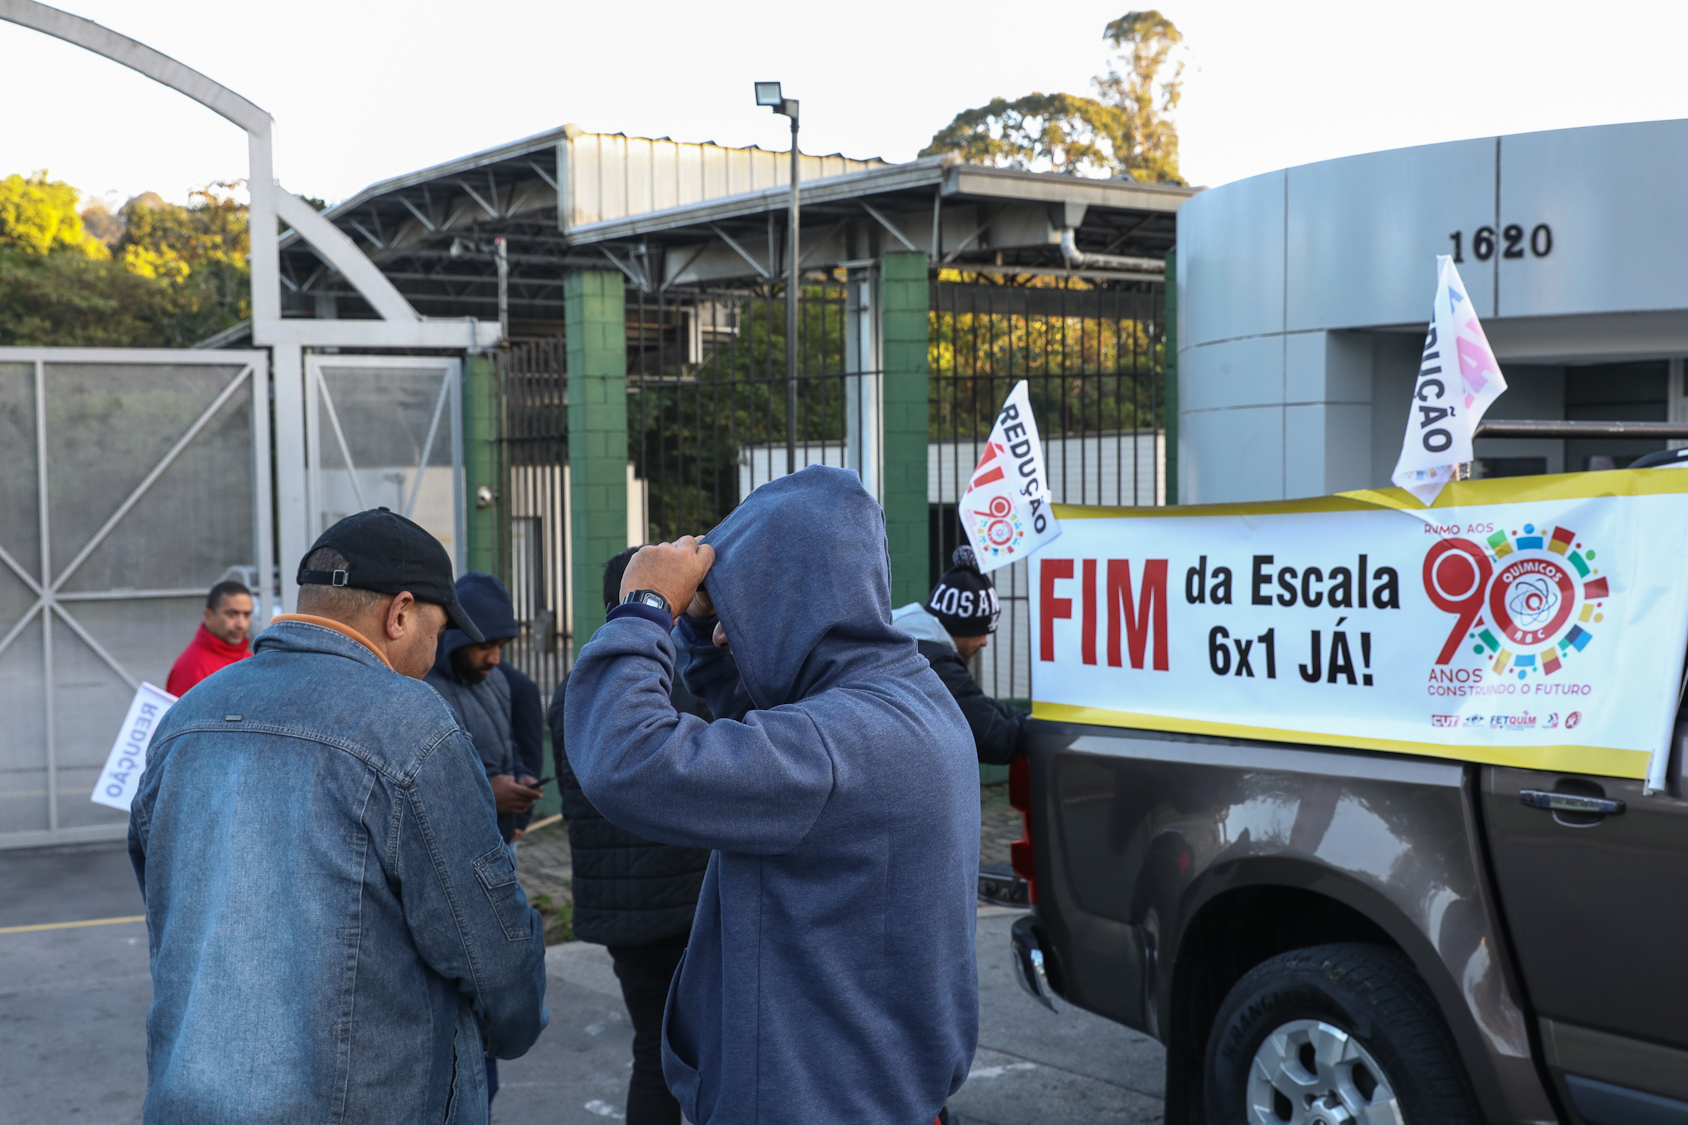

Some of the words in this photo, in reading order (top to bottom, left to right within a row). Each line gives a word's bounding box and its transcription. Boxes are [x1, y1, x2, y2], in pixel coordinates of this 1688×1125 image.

[1449, 223, 1553, 263] 1620
[1000, 403, 1047, 535] REDUÇÃO
[1466, 522, 1494, 534] AOS
[1185, 555, 1232, 604] da
[1251, 554, 1401, 609] Escala
[930, 583, 974, 618] LOS
[1039, 558, 1169, 671] FIM
[1208, 625, 1276, 679] 6x1
[1298, 616, 1374, 686] JÁ!
[1427, 683, 1516, 696] CONSTRUINDO
[1520, 683, 1531, 695] O
[1535, 683, 1592, 696] FUTURO
[1428, 668, 1483, 683] ANOS
[1432, 715, 1459, 727] CUT
